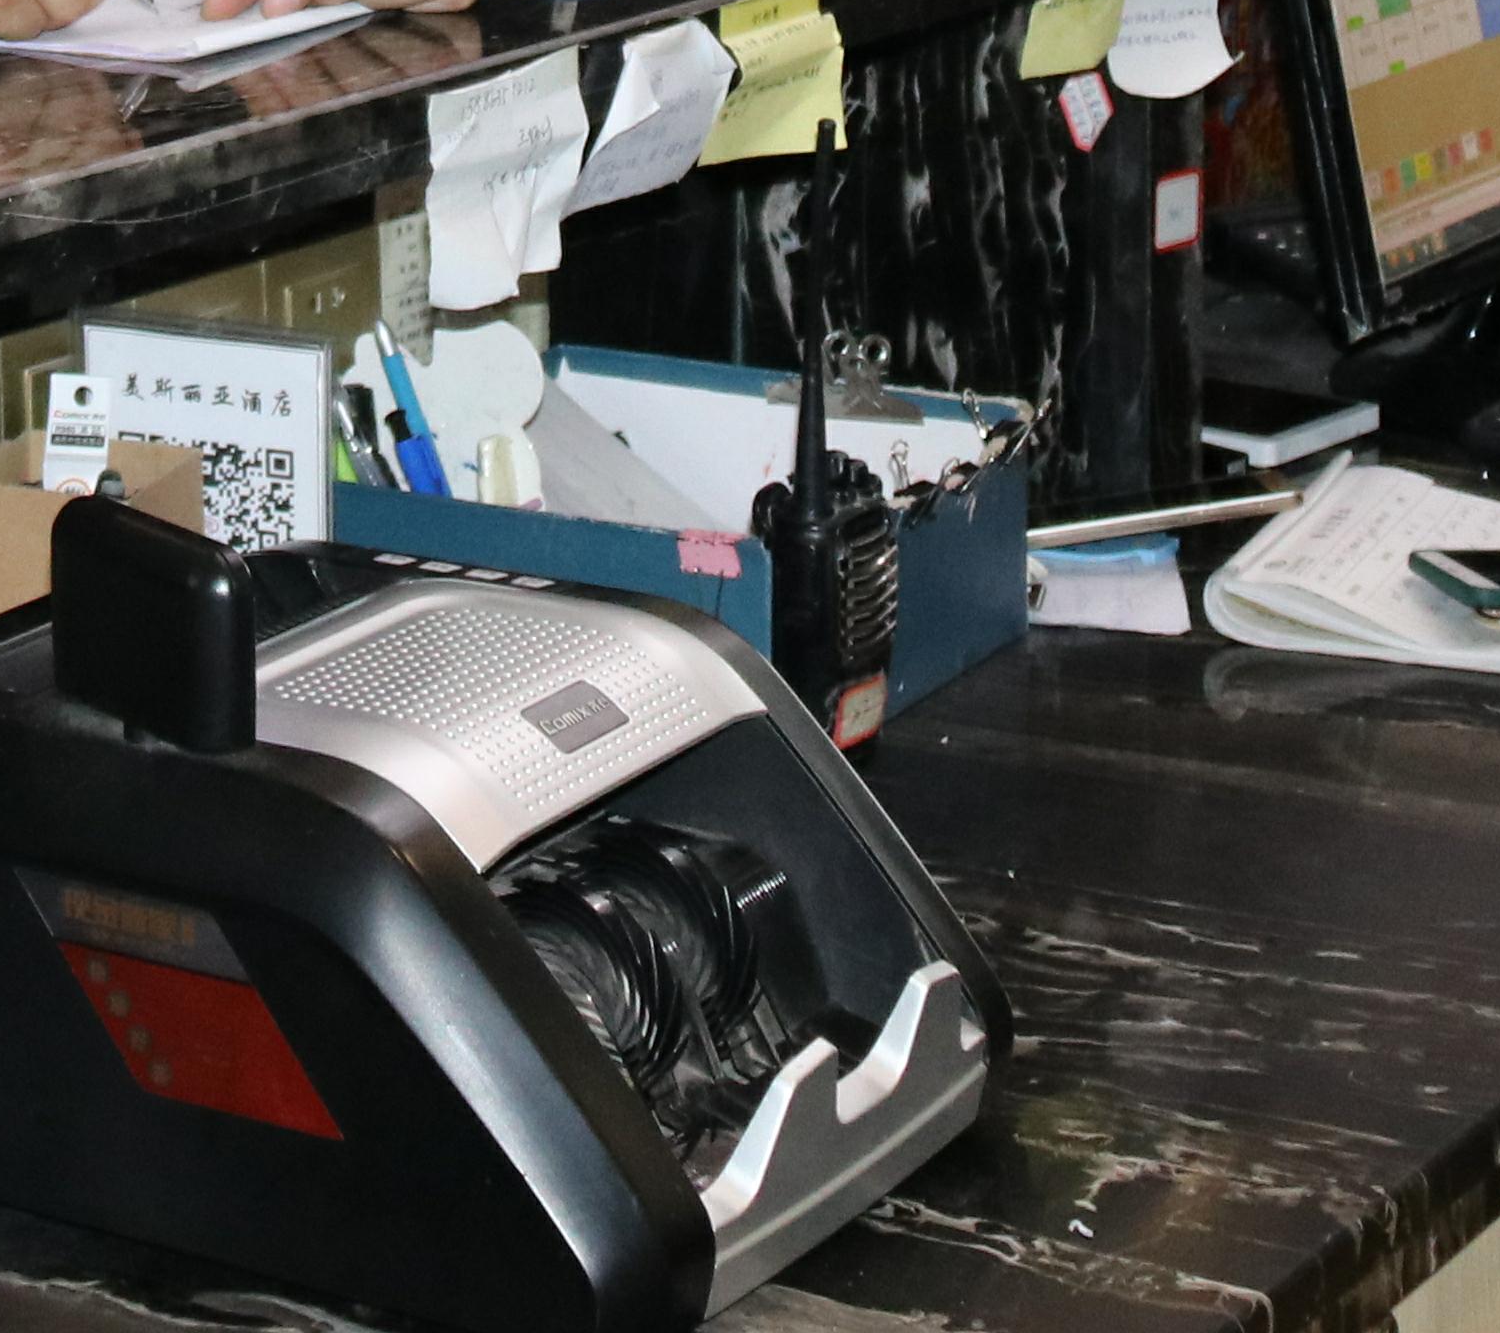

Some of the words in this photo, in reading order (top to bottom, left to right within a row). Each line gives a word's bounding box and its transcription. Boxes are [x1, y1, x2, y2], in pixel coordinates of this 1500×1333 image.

[121, 372, 292, 417] 美斯丽亚酒店
